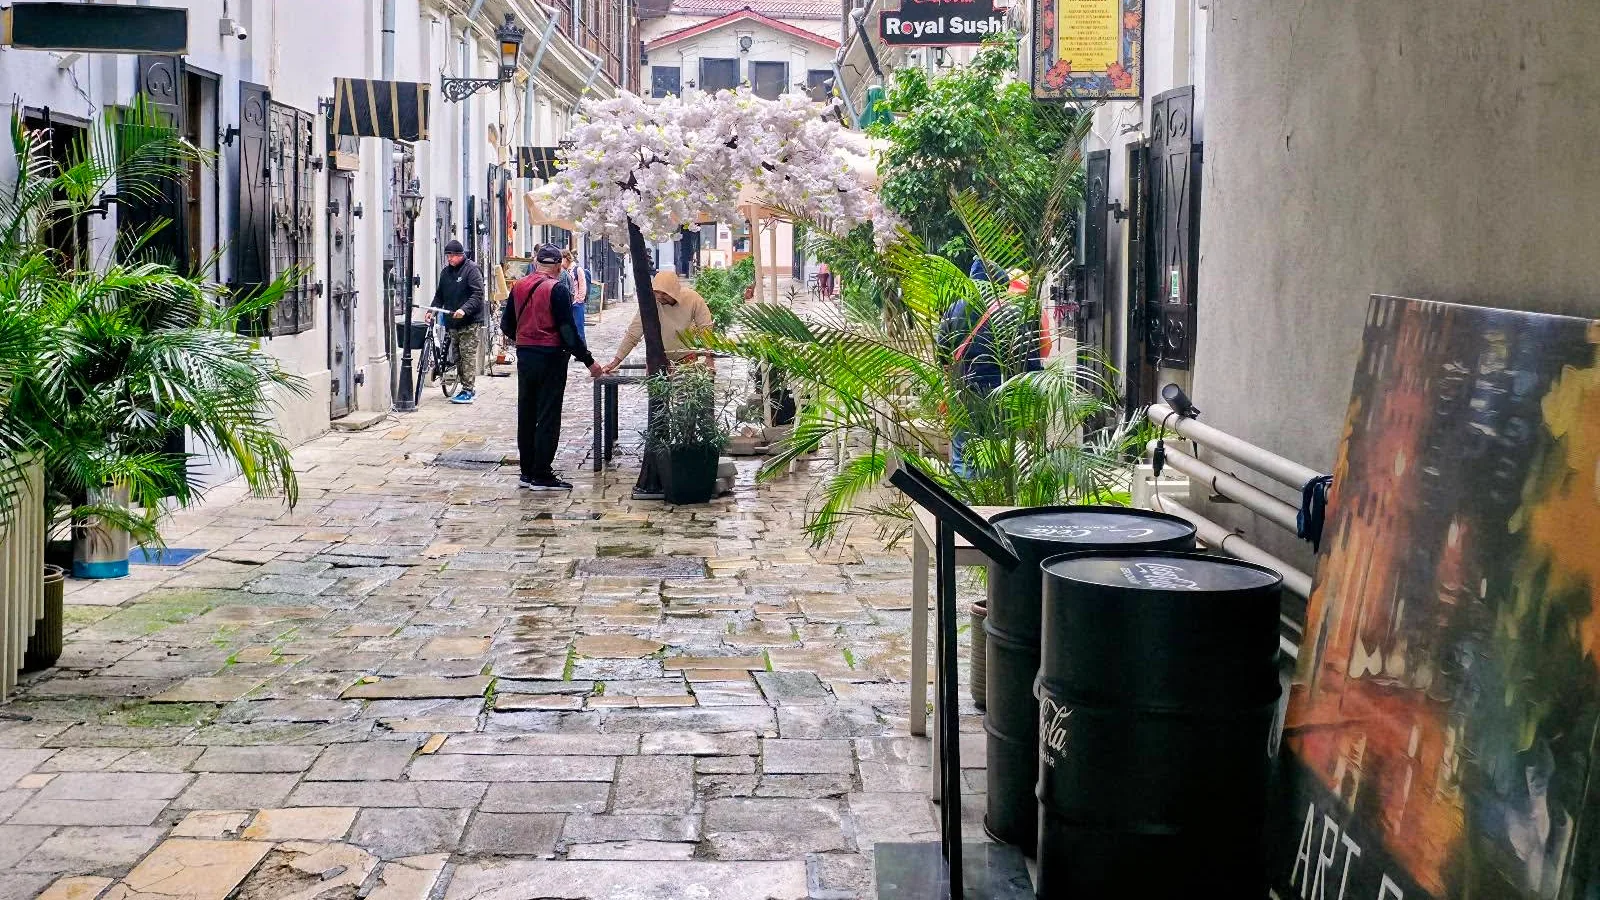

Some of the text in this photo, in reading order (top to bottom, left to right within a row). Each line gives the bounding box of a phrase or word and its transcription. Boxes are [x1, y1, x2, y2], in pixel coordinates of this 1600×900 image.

[886, 16, 1007, 38] Royal Sushi
[1289, 802, 1361, 900] ART
